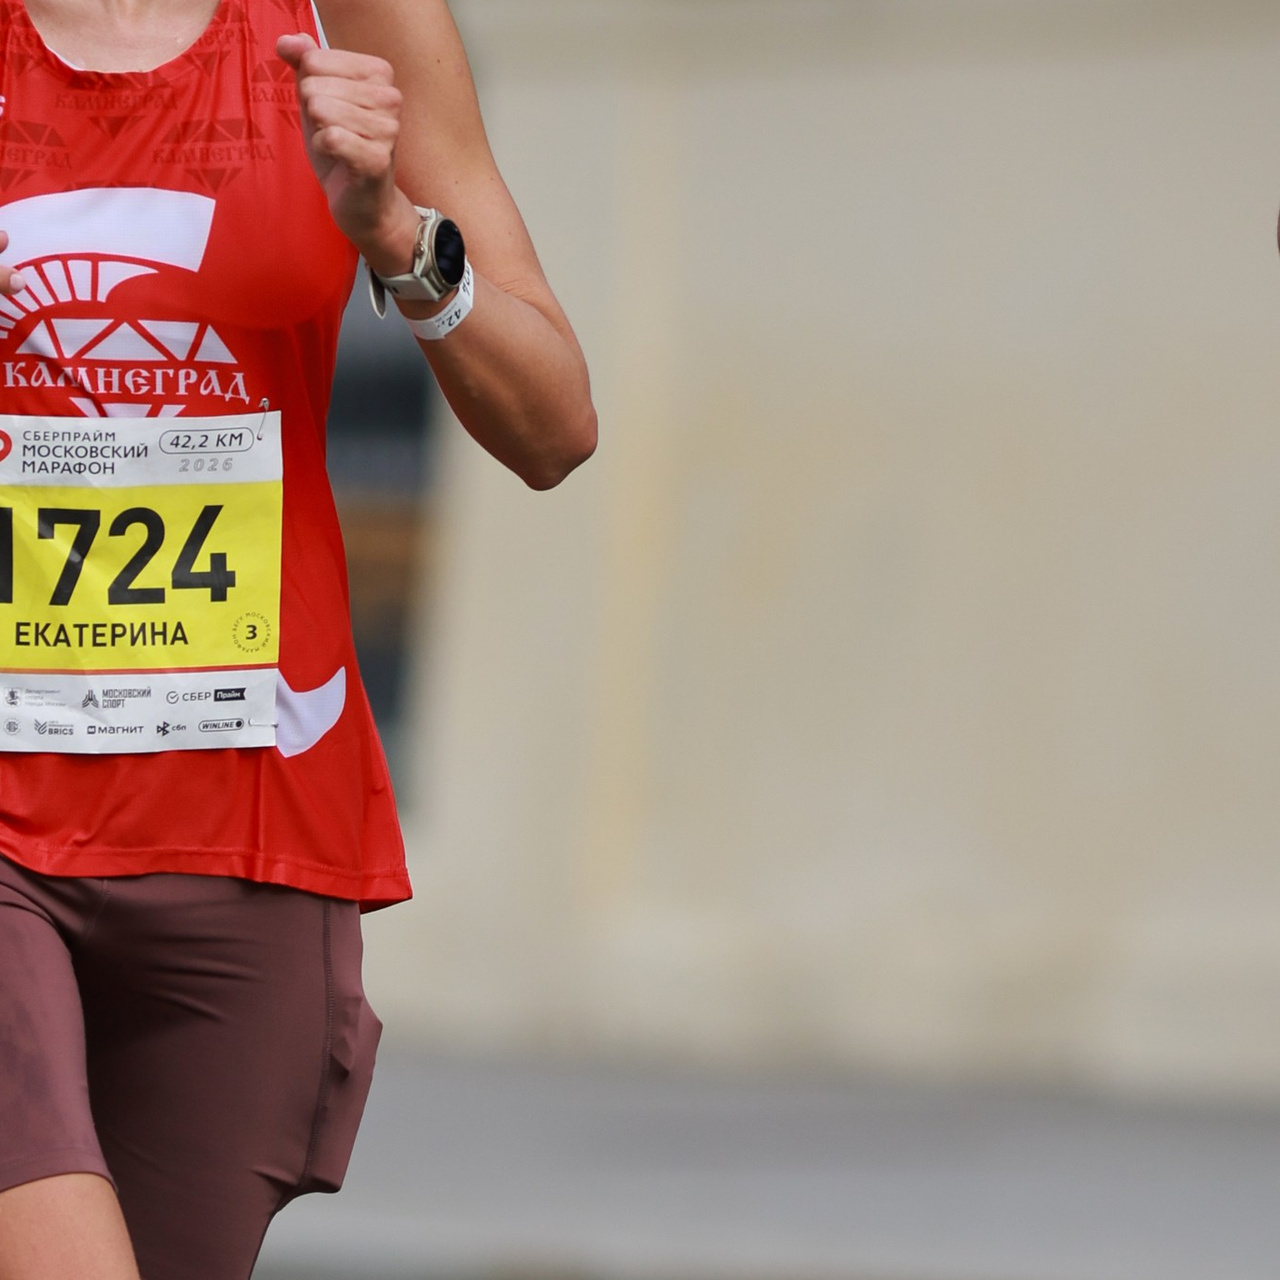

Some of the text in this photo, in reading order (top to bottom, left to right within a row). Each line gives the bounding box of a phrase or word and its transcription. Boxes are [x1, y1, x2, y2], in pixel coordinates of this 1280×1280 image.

[3, 361, 250, 404] КАМНЕГРАД
[22, 430, 116, 442] СБЕРПРАЙМ
[170, 433, 244, 450] 42,2 КМ
[22, 443, 148, 459] МОСКОВСКИЙ
[22, 460, 115, 475] МАРАФОН
[178, 457, 234, 472] 2026
[14, 621, 189, 648] ЕКАТЕРИНА
[245, 624, 257, 640] 3
[102, 686, 152, 698] МОСКОВСКИЙ
[182, 692, 211, 702] СБЕР
[102, 699, 125, 709] СПОРТ
[48, 728, 74, 736] BRICS
[201, 721, 235, 730] WINLINE
